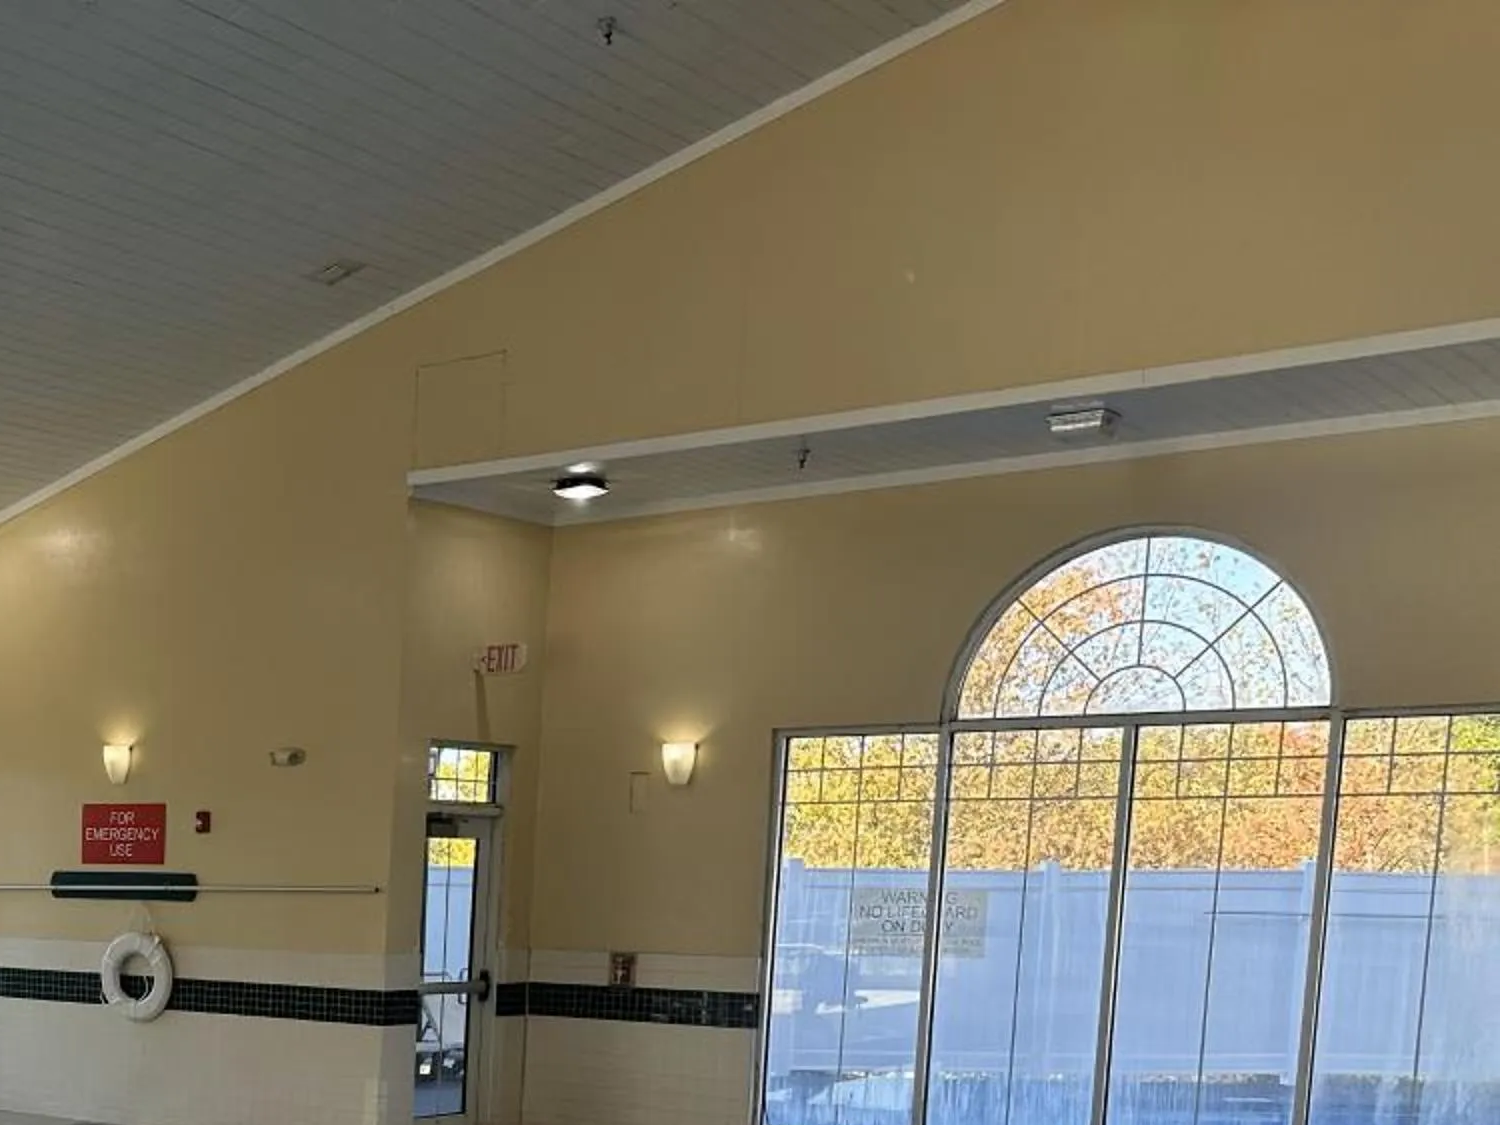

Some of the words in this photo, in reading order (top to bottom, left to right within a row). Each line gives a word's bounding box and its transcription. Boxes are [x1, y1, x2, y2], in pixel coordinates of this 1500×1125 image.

[487, 643, 519, 672] EXIT
[109, 811, 135, 825] FOR
[85, 827, 159, 841] EMERGENCY
[109, 843, 133, 857] USE
[859, 905, 882, 918] NO
[881, 920, 905, 933] ON
